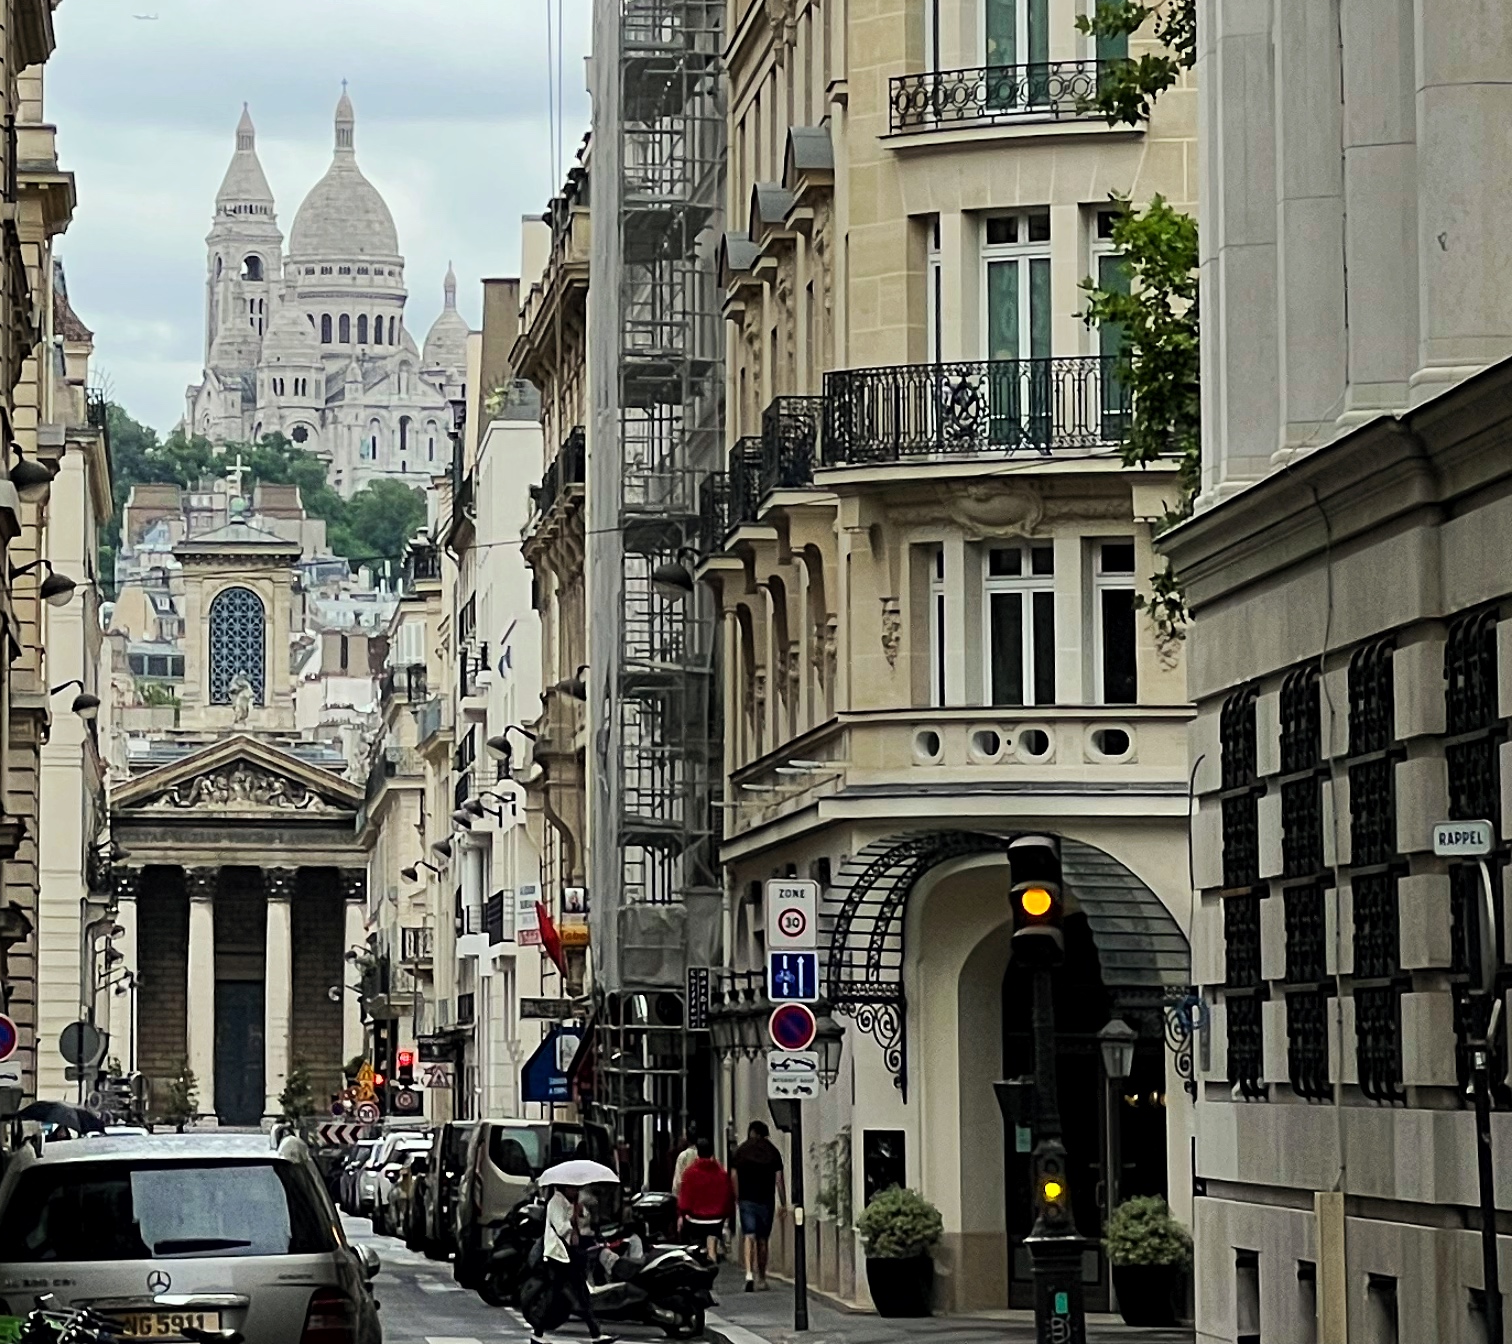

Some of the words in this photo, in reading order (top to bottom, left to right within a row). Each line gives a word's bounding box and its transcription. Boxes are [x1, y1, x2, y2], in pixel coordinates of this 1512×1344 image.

[1439, 831, 1484, 846] RAPPEL
[779, 888, 806, 899] ZONE
[785, 916, 800, 929] 30
